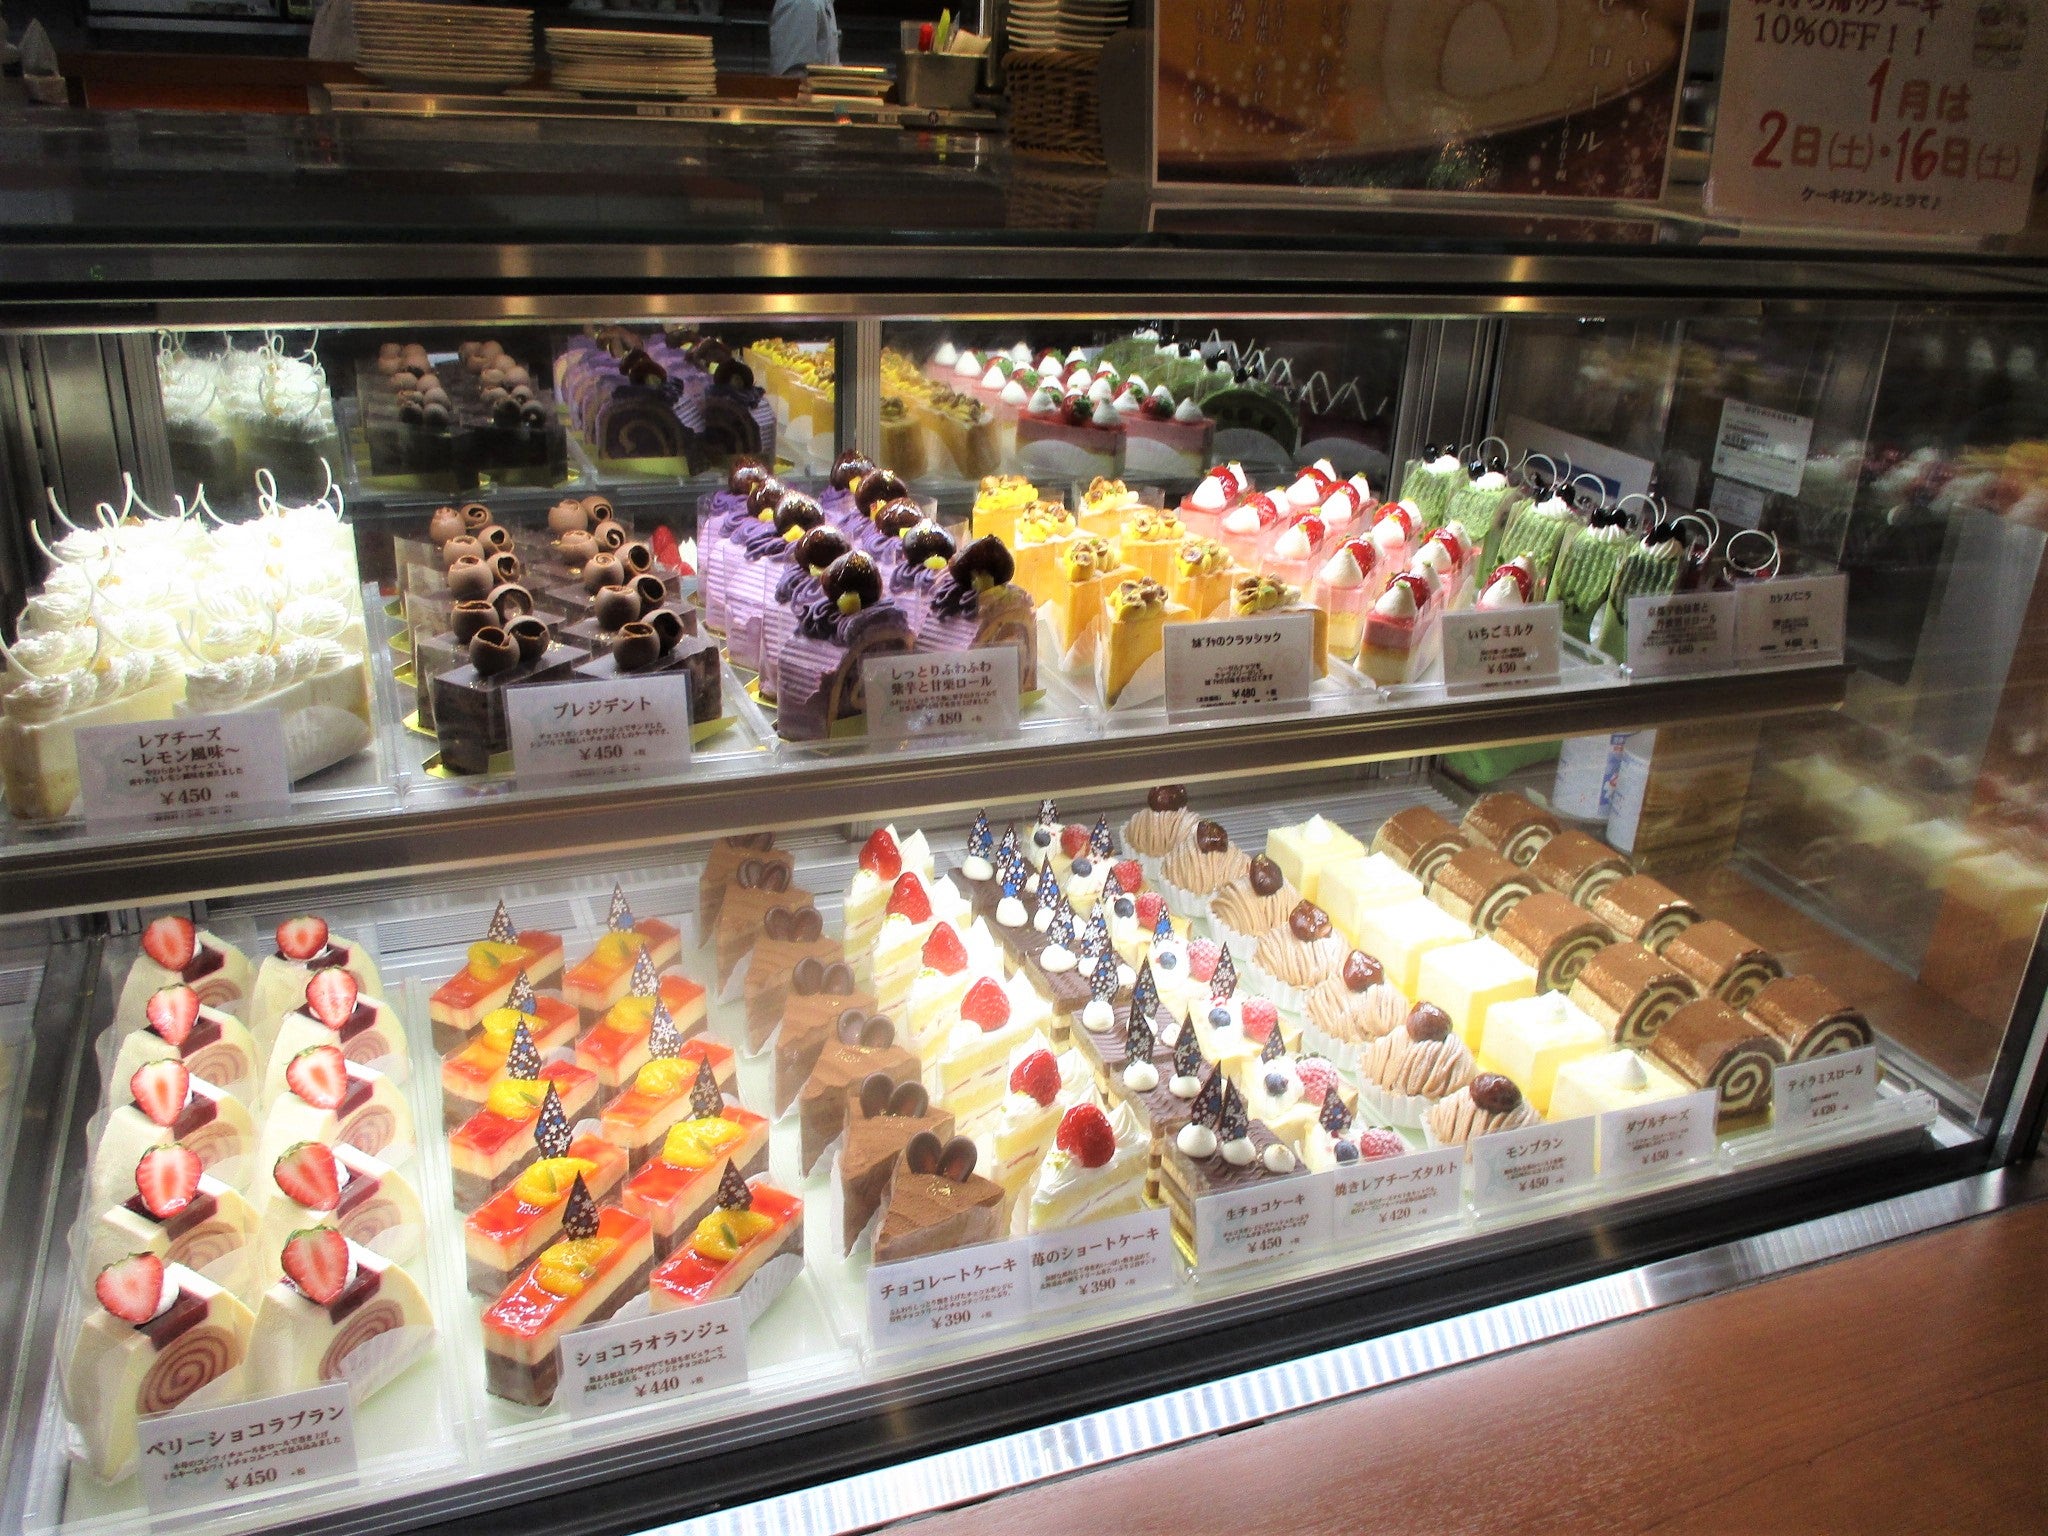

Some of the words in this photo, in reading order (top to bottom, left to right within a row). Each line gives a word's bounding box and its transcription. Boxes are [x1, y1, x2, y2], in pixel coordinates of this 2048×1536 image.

[1867, 57, 1972, 123] 1月は
[1468, 623, 1534, 640] いちごミルク
[892, 660, 992, 680] しっとりふわふわ
[891, 678, 992, 696] 紫芋と甘栗ロール
[553, 696, 651, 719] プレジデント
[138, 726, 222, 749] レアチーズ
[1506, 1138, 1564, 1159] モンブラン
[1334, 1161, 1458, 1198] 焼きレアチーズタルト
[1226, 1193, 1305, 1222] 生チョコケーキ
[1032, 1226, 1159, 1267] 苺のショートケーキ
[880, 1257, 1017, 1301] チョコレートケーキ
[576, 1321, 729, 1367] ショコラオランジュ
[635, 1376, 680, 1398] ¥440
[146, 1406, 345, 1457] ベリーショコラブラン
[225, 1467, 278, 1491] ¥450
